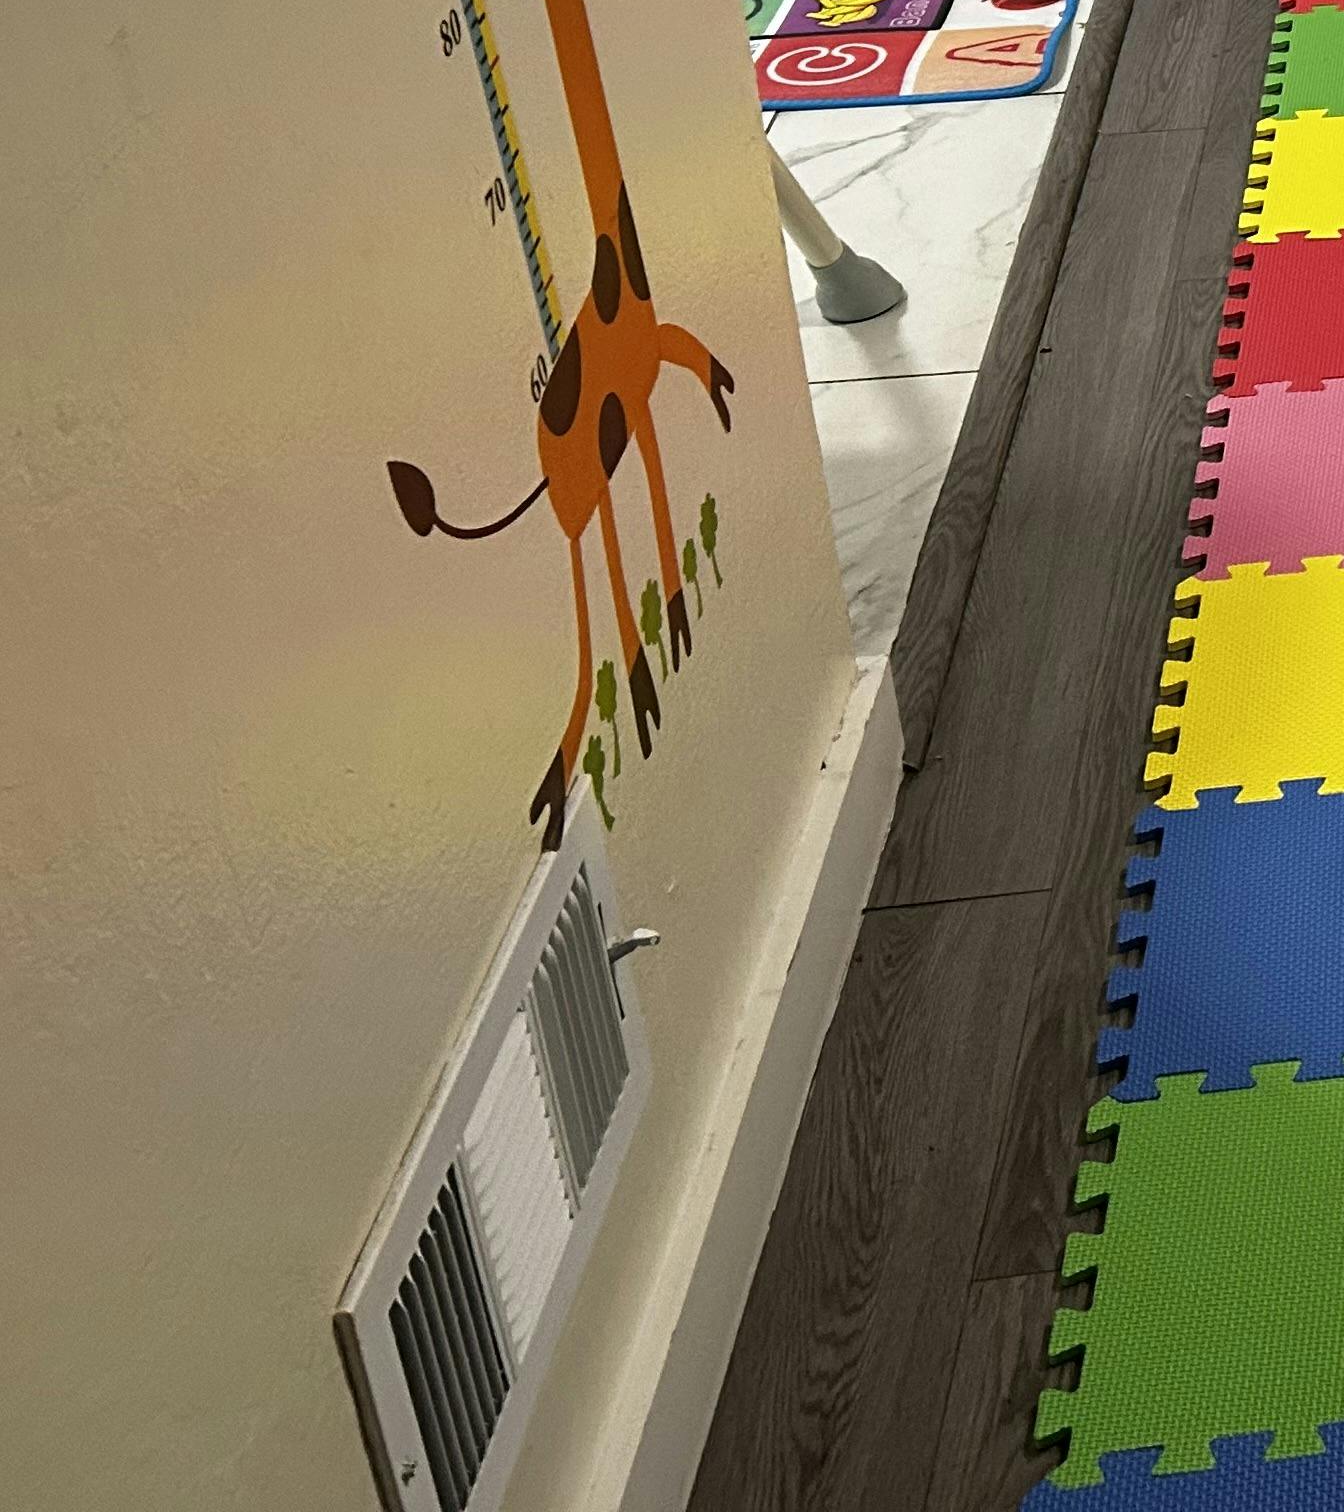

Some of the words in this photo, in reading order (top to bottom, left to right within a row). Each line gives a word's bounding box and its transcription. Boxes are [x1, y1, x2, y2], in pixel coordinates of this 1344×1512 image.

[440, 8, 462, 57] 80
[945, 31, 1054, 67] A
[766, 42, 888, 86] C
[484, 176, 506, 227] 70
[529, 352, 549, 404] 60
